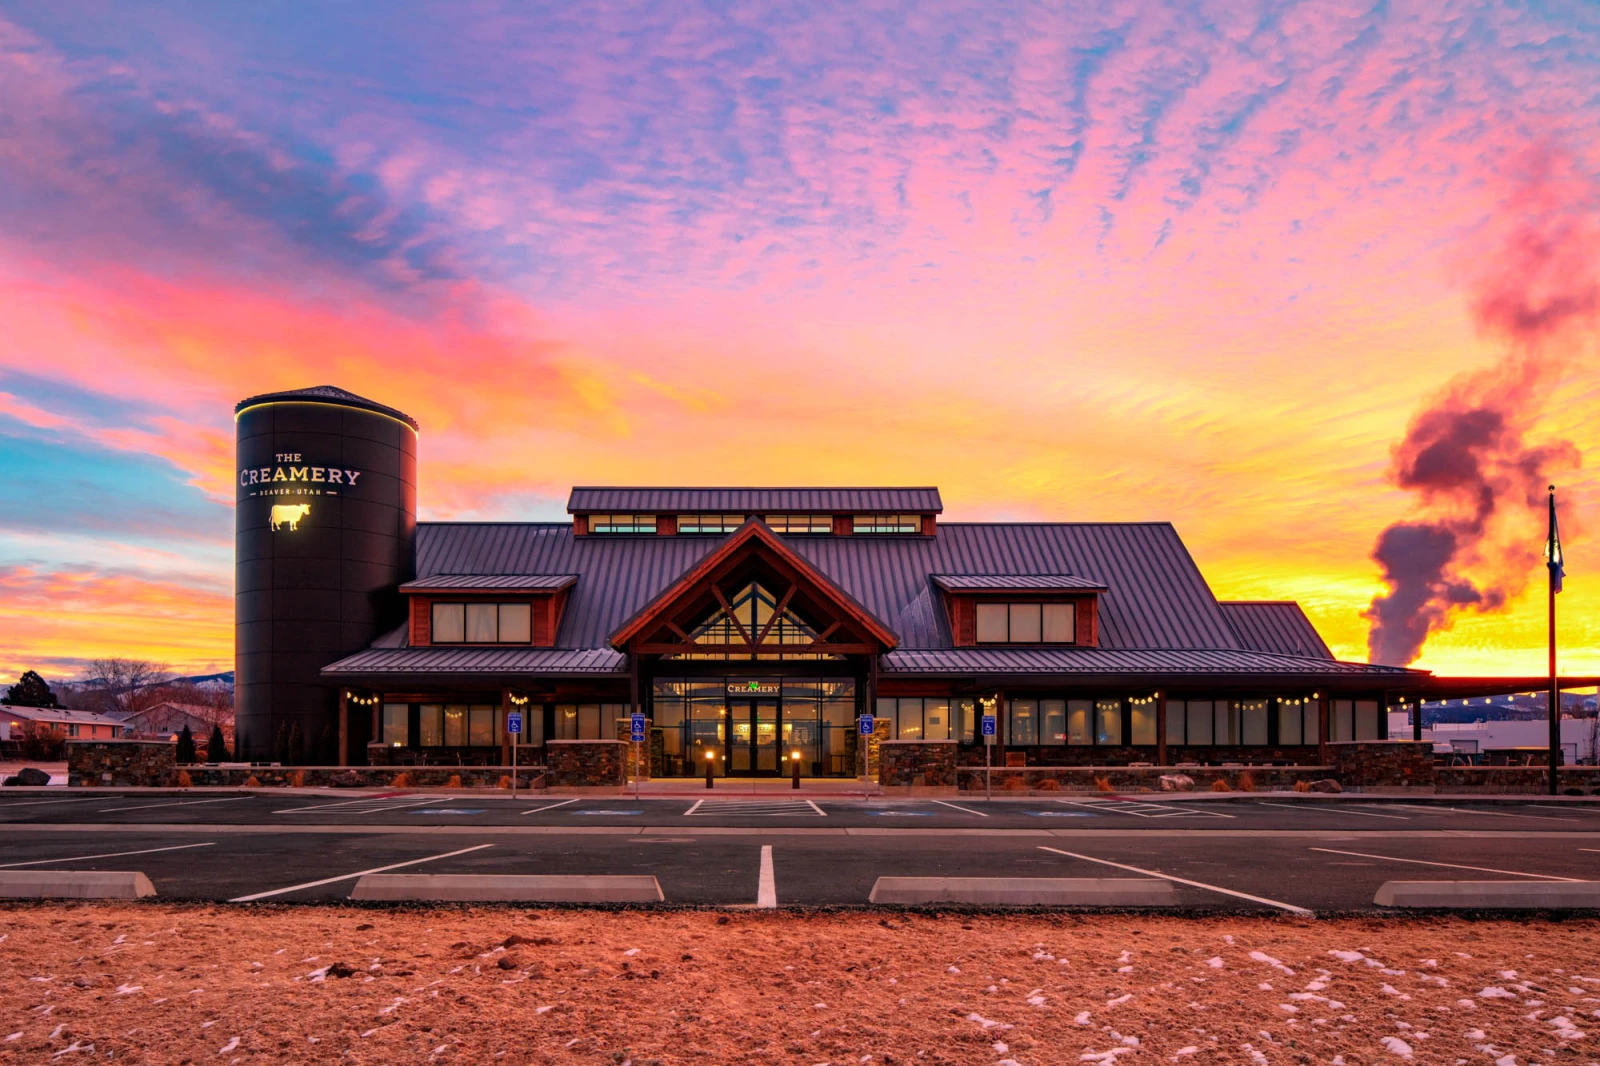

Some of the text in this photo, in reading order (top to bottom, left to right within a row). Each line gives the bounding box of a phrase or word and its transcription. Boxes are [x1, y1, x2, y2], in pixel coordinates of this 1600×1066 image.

[276, 453, 302, 462] THE
[240, 466, 361, 486] CREAMERY
[727, 685, 780, 693] CREAMERY
